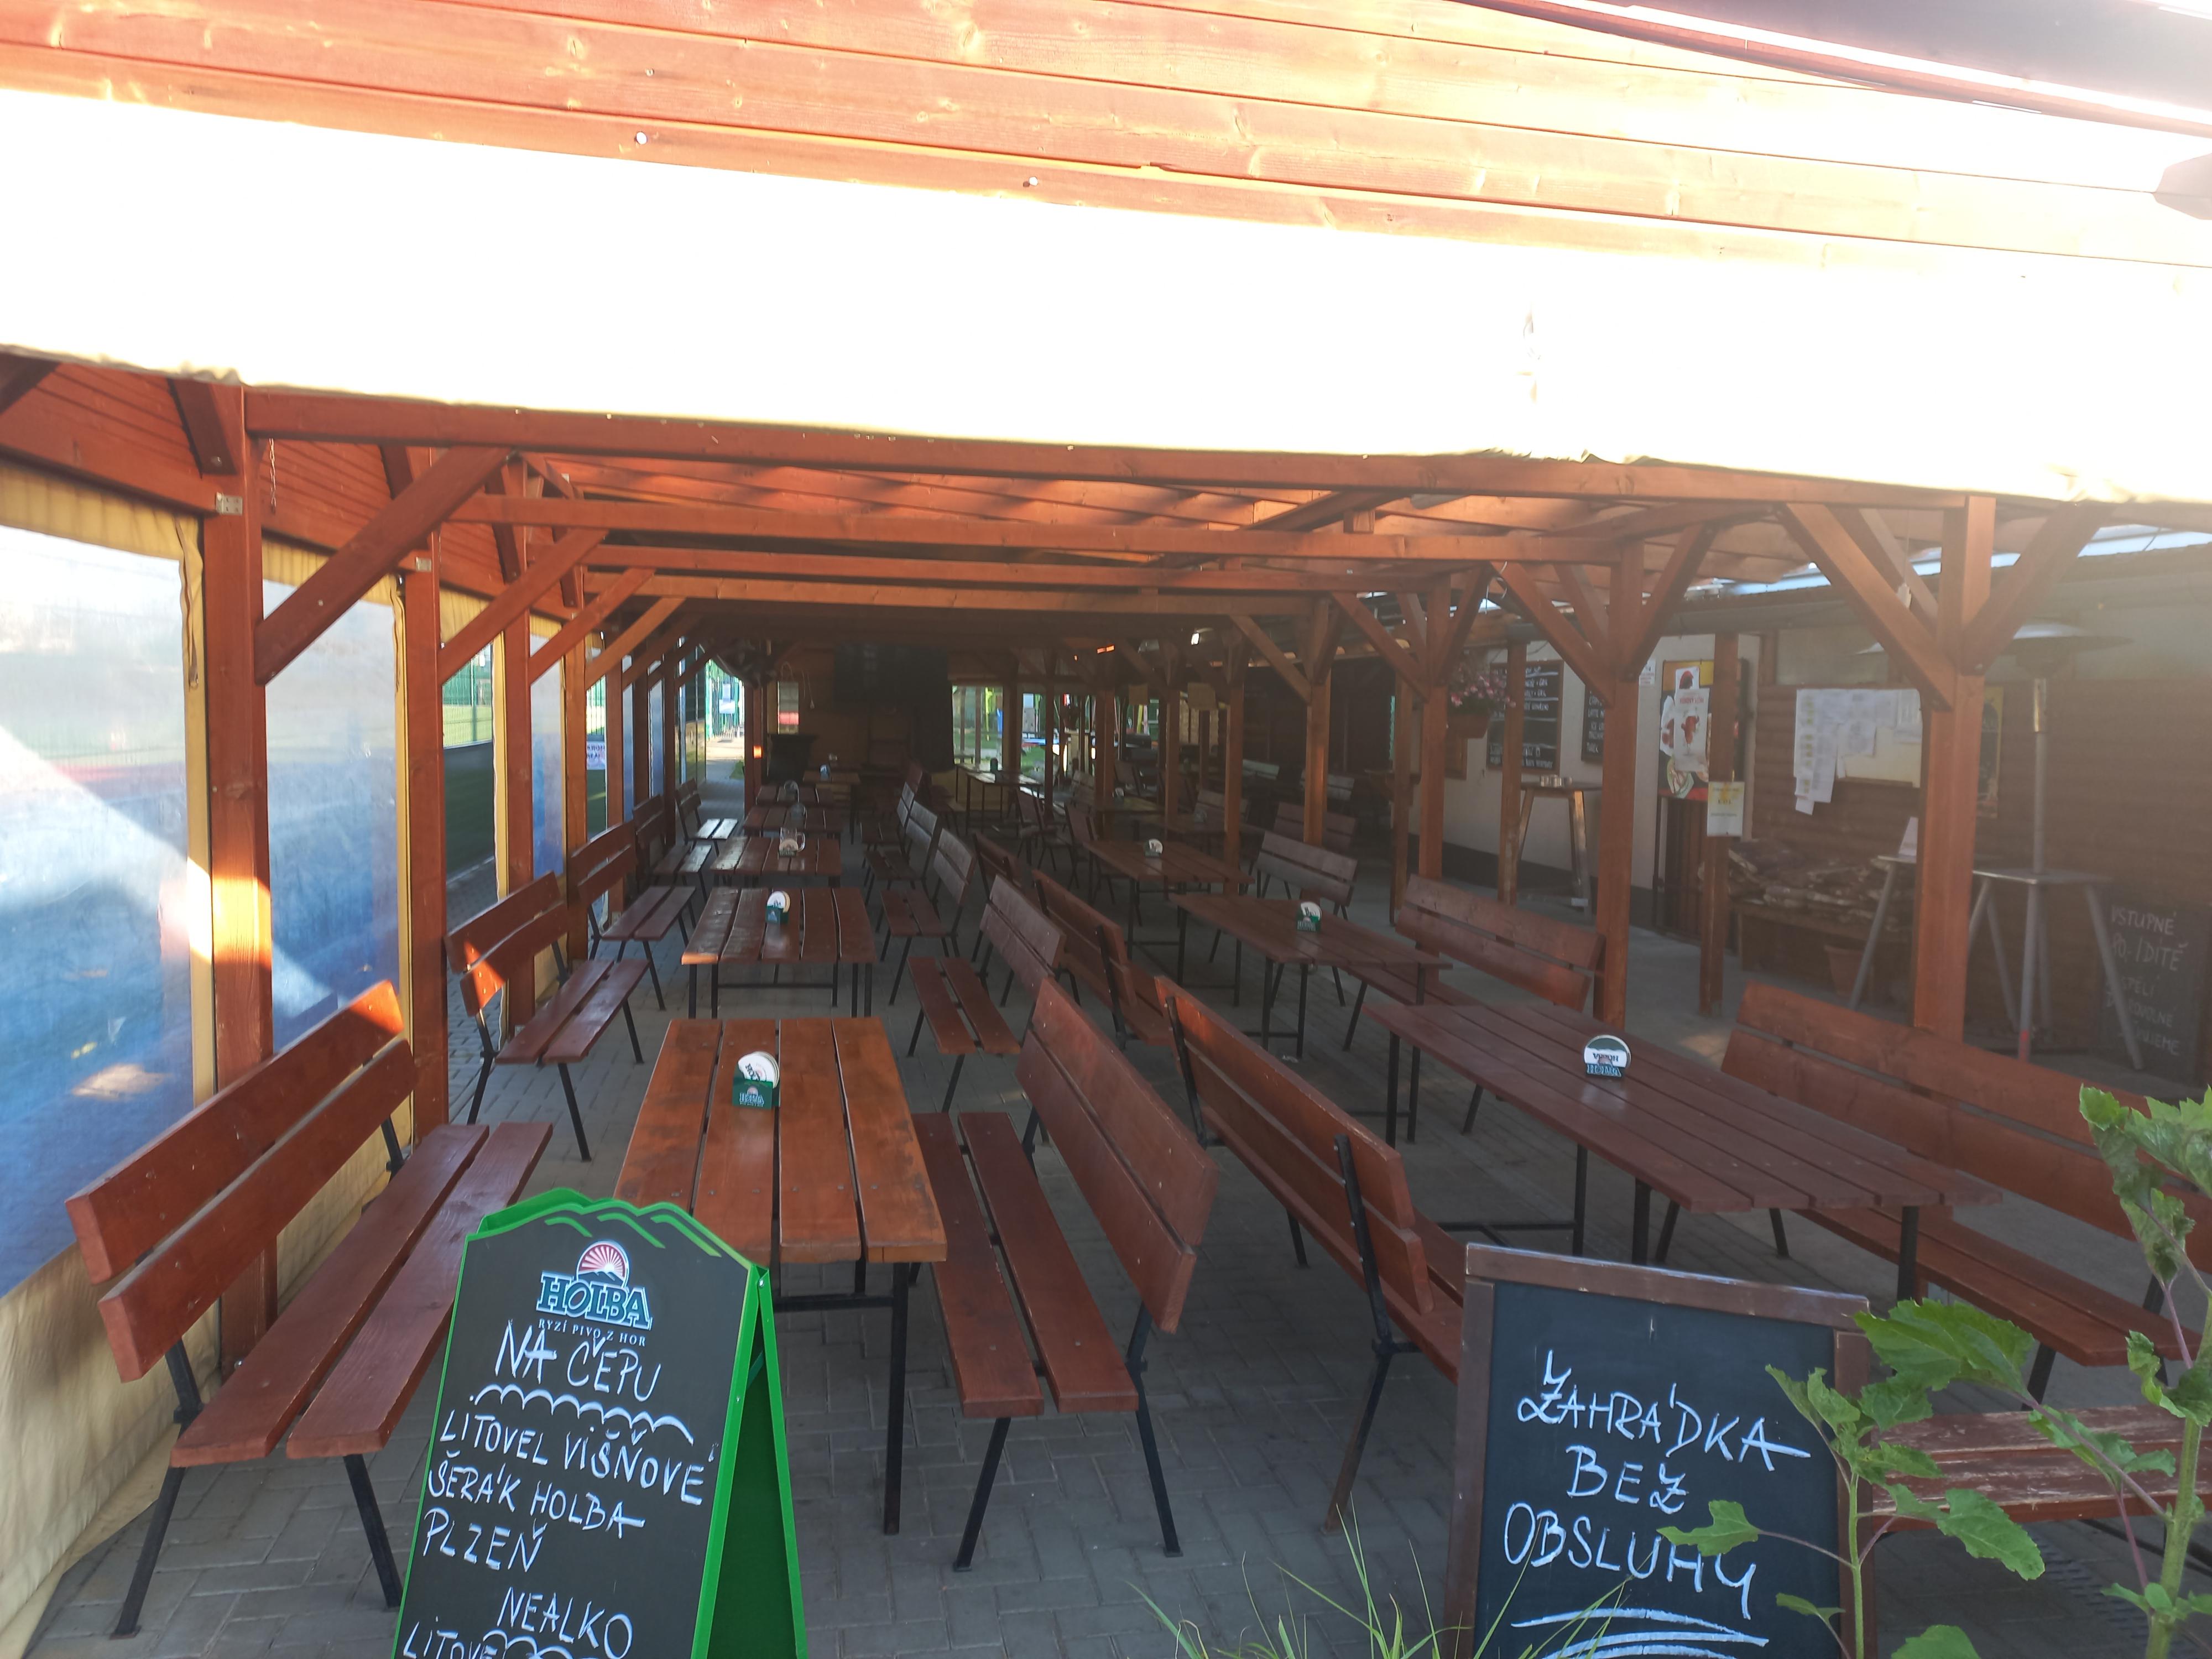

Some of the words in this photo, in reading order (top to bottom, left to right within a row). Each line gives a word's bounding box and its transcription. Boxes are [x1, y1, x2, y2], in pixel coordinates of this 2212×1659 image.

[2111, 905, 2177, 936] VSTUPNÉ
[536, 1271, 653, 1331] HOLBA
[538, 1318, 567, 1333] RYZÍ
[572, 1324, 601, 1339] PIVO
[606, 1330, 614, 1341] Z
[619, 1333, 646, 1347] HOR
[494, 1320, 557, 1384] NA
[567, 1335, 661, 1402] ČEPU
[439, 1409, 549, 1467] LITOVEL
[427, 1449, 521, 1512] ŠERÁK
[531, 1480, 645, 1540] HOLBA
[422, 1507, 548, 1572] PLZEŇ
[1504, 1502, 1756, 1621] OBSLUHY
[497, 1587, 633, 1659] NEALKO
